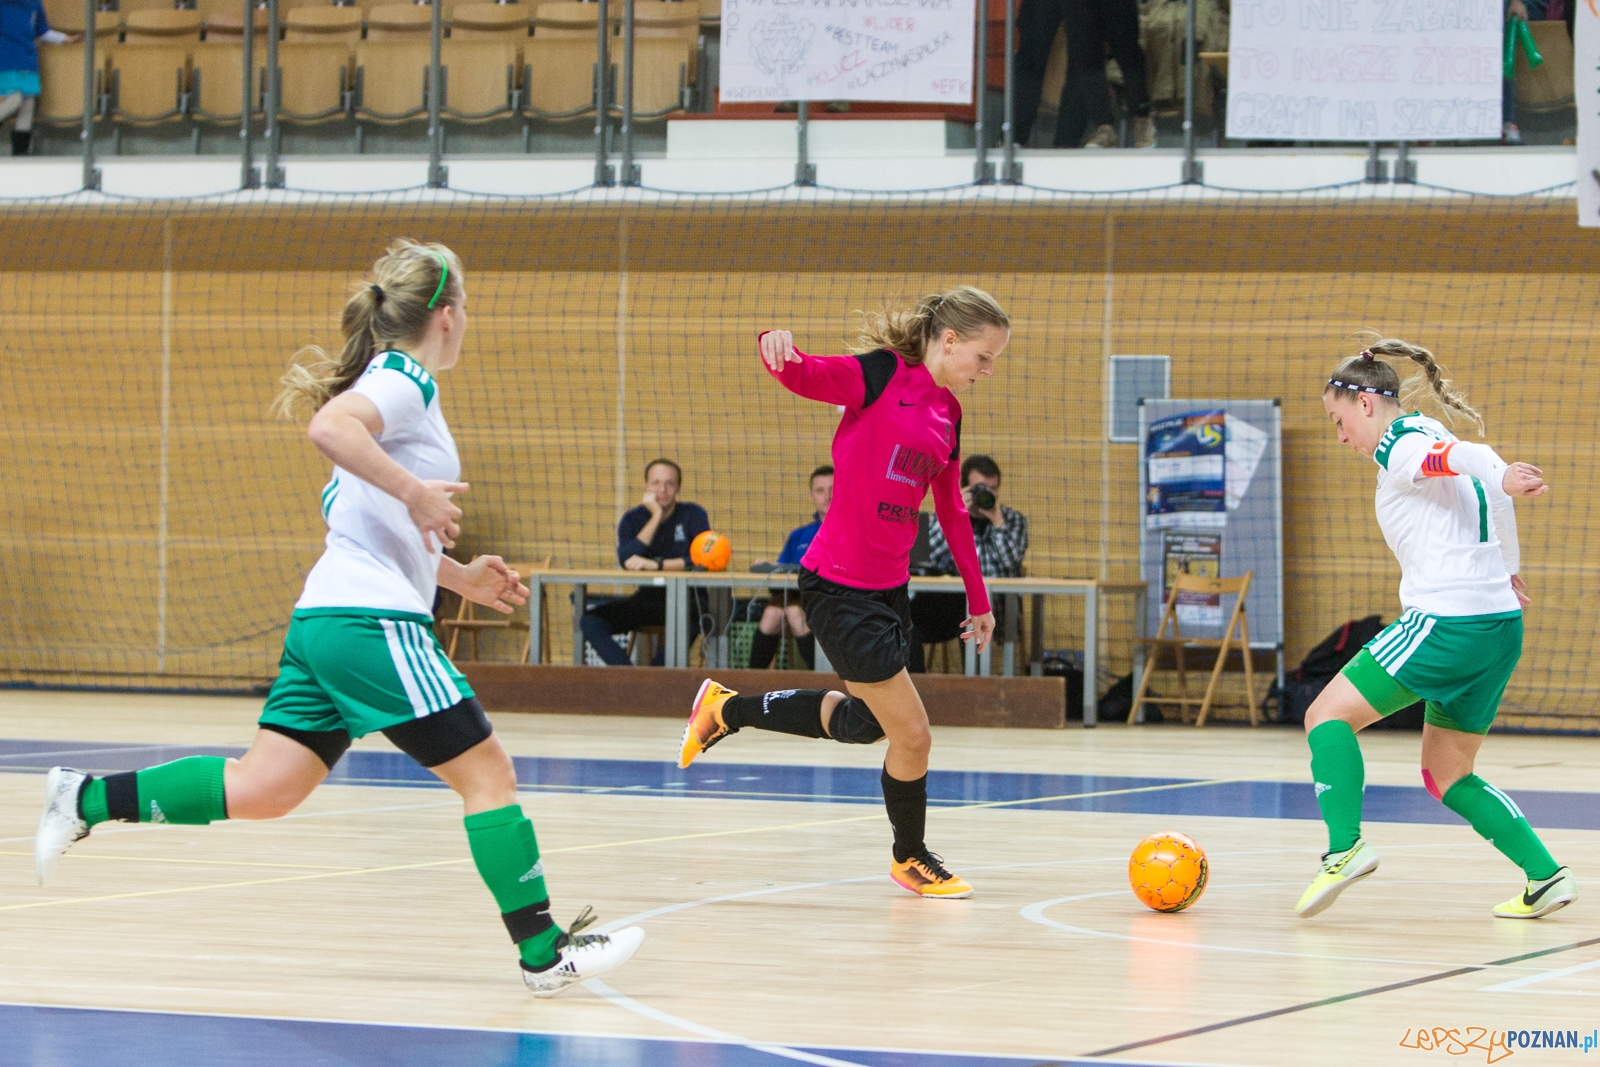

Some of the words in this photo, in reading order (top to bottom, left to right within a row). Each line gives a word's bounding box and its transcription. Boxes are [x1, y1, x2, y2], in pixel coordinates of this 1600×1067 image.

[1233, 0, 1286, 29] TO
[1299, 0, 1359, 31] NIE
[1231, 46, 1280, 80] TO
[1292, 44, 1400, 83] NASZE
[1338, 99, 1379, 136] NA
